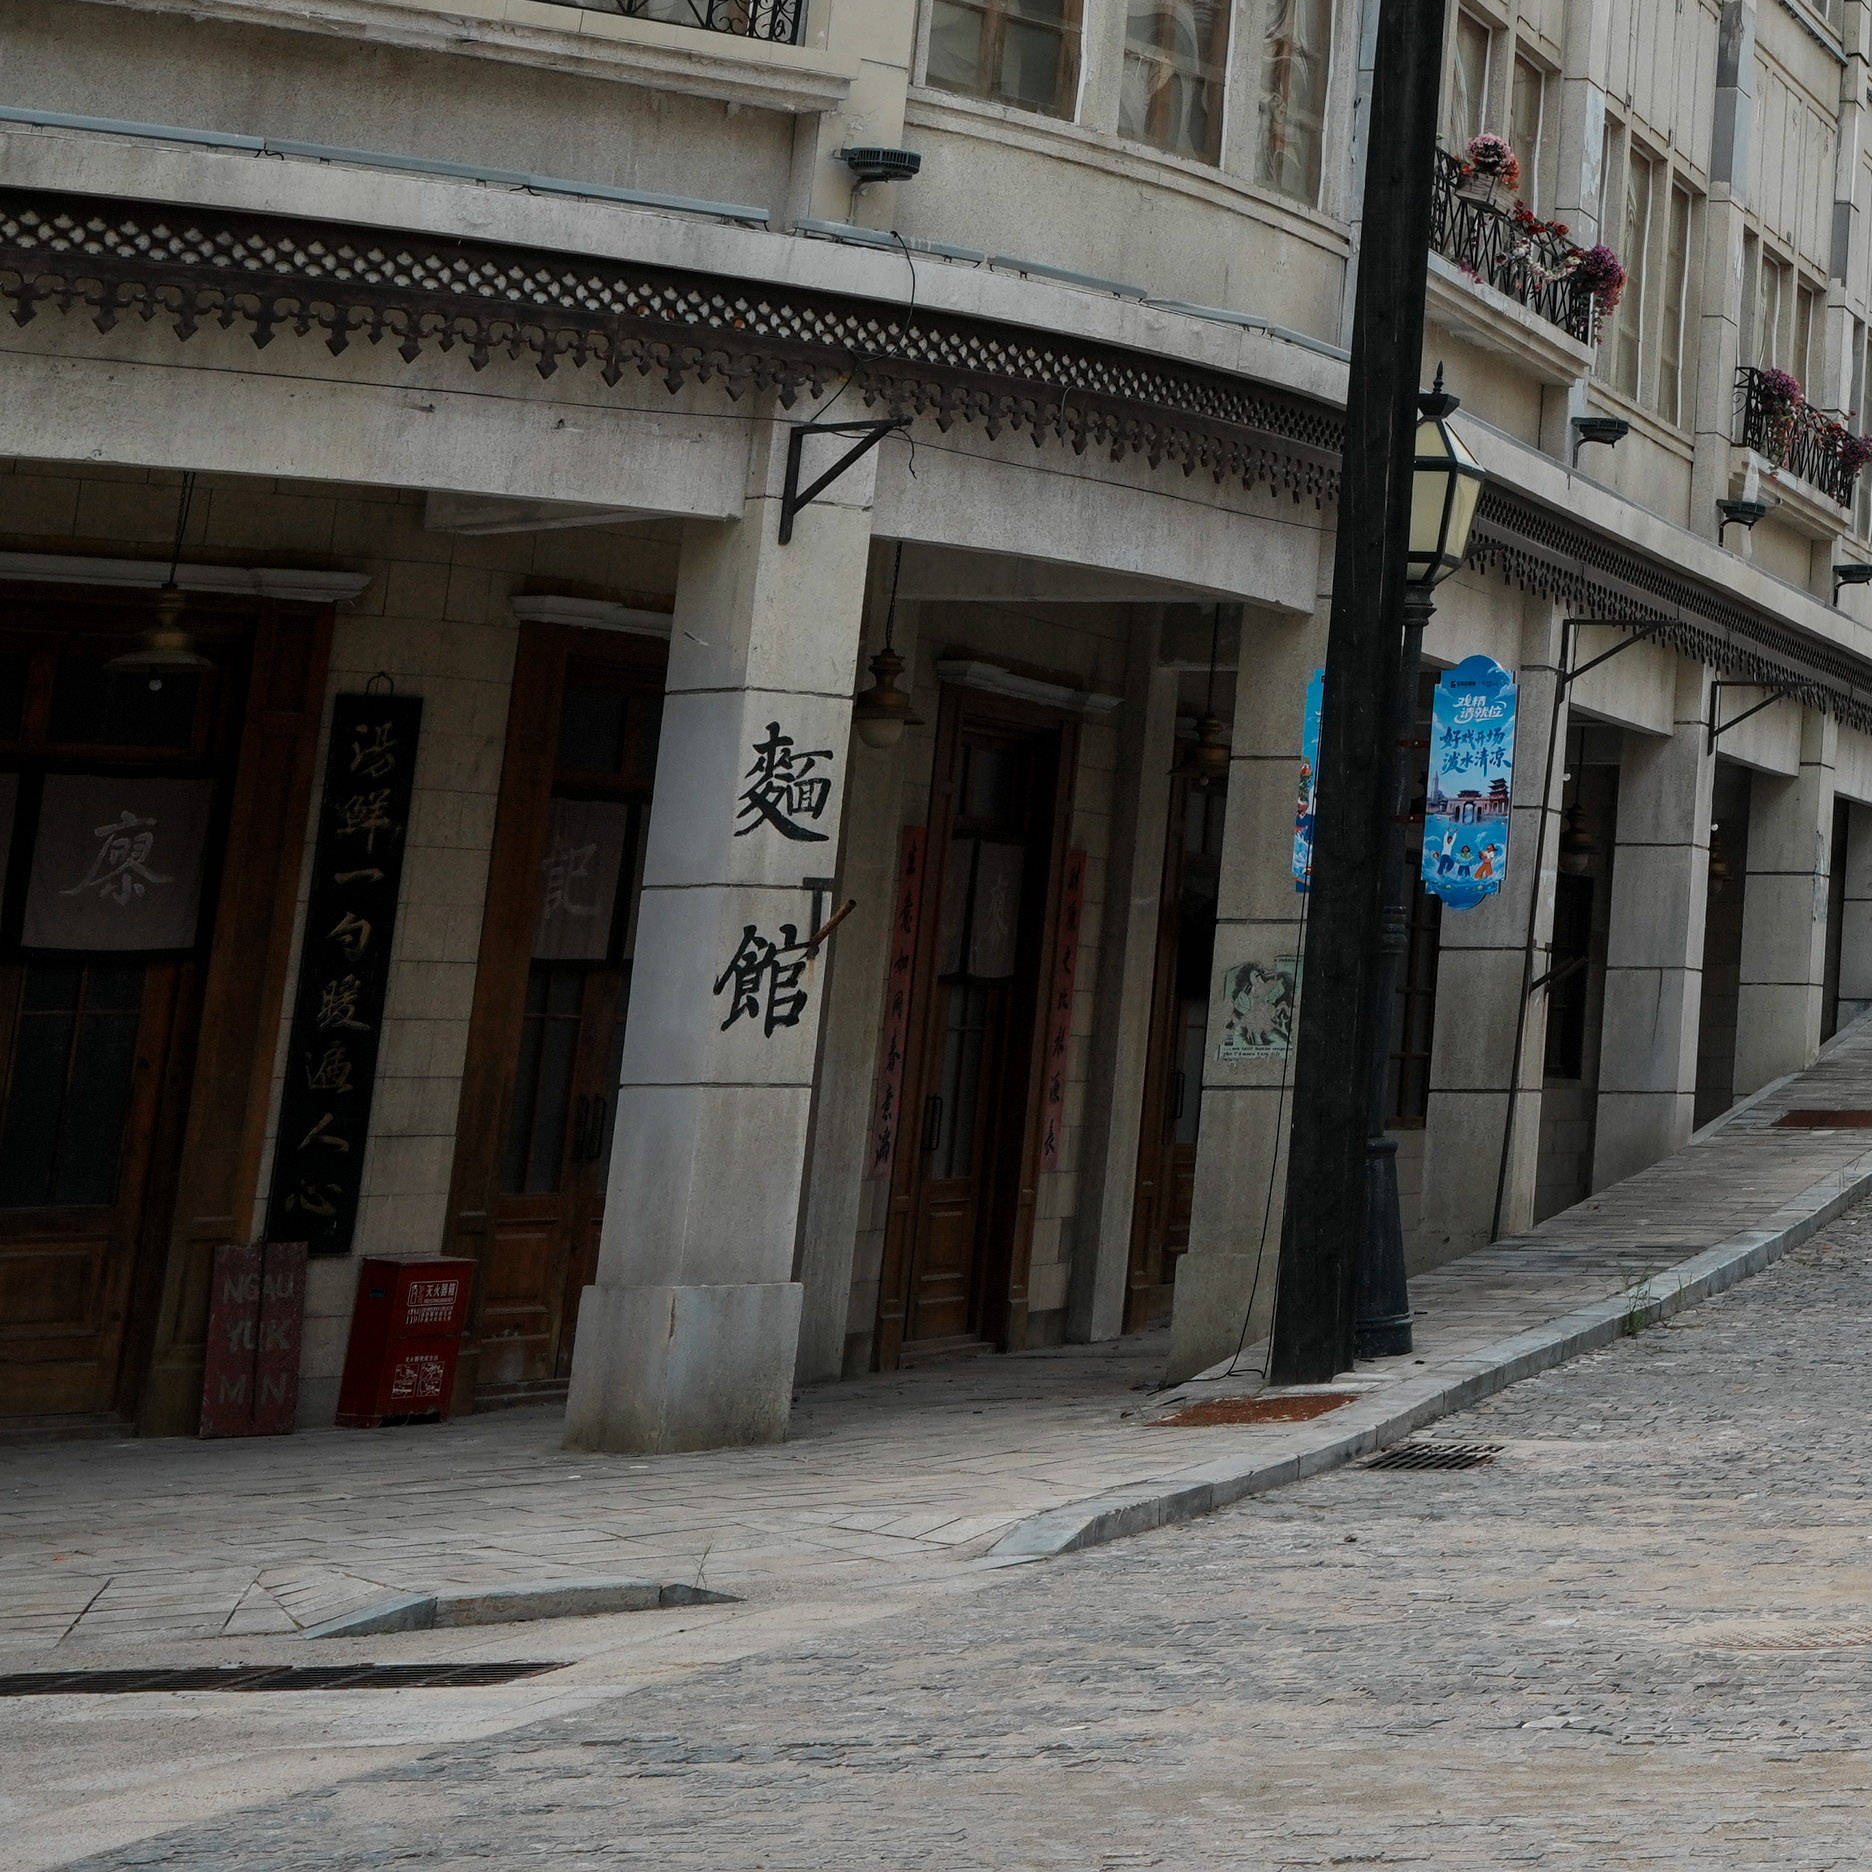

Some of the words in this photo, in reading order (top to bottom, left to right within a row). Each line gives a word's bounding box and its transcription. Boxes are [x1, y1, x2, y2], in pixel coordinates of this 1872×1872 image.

[1440, 727, 1506, 750] 好戏开场
[1440, 747, 1512, 776] 泼水清凉
[713, 721, 834, 1039] 麵館
[218, 1372, 287, 1407] MN
